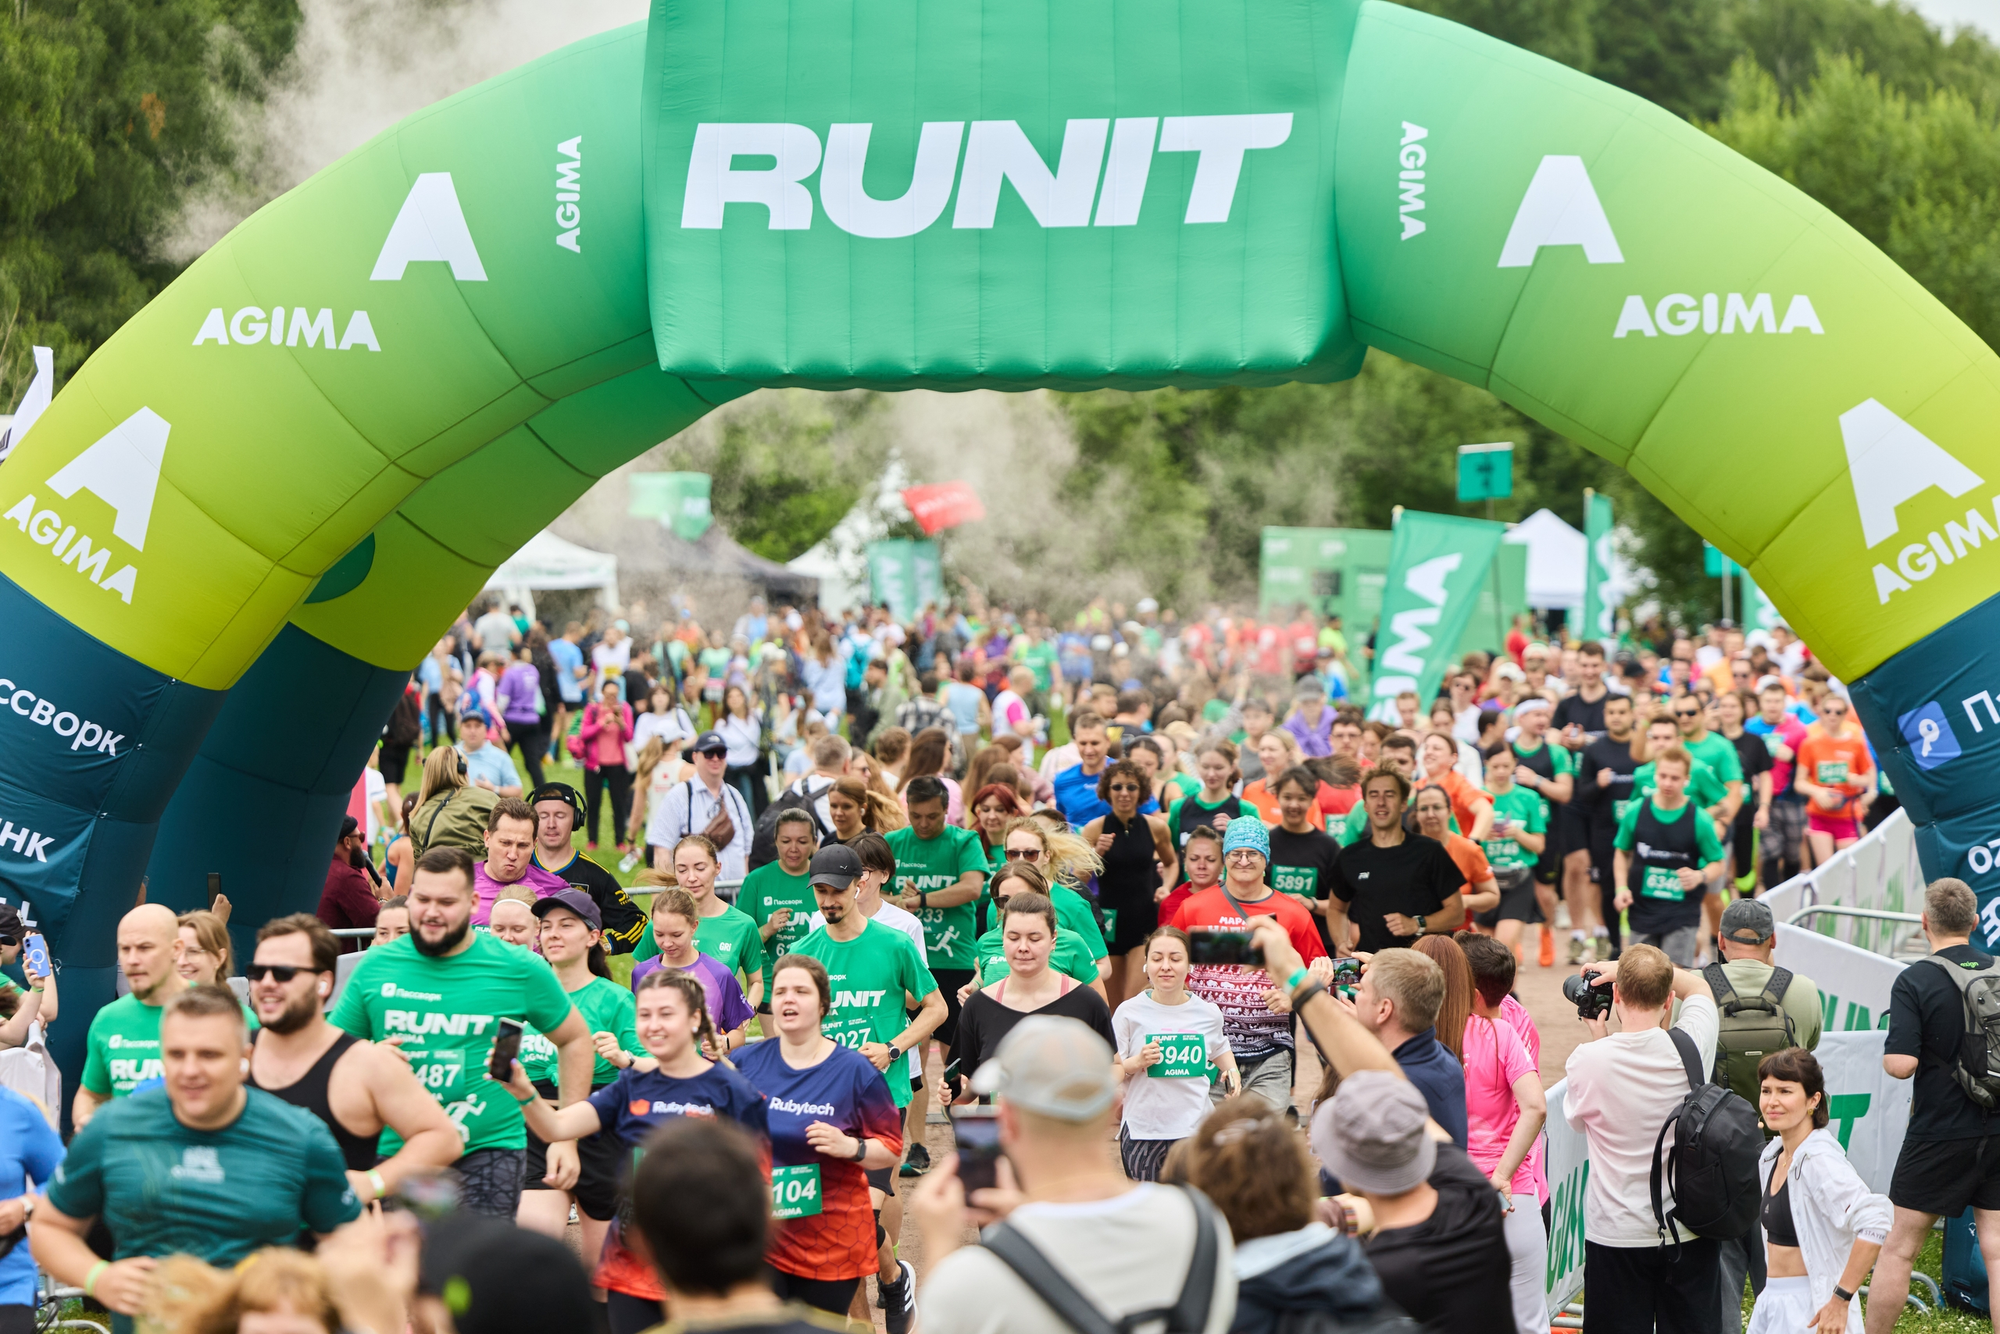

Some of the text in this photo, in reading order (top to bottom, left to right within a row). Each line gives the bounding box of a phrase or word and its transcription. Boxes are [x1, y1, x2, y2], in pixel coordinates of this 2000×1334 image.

[680, 112, 1294, 239] RUNIT
[1398, 120, 1430, 241] AGIMA
[555, 135, 583, 254] AGIMA
[192, 305, 382, 352] AGIMA
[1612, 292, 1826, 339] AGIMA
[2, 493, 138, 606] AGIMA
[1871, 493, 2000, 605] AGIM
[1961, 689, 2000, 733] П
[1274, 875, 1314, 891] 5891
[384, 1009, 495, 1035] RUNIT
[1153, 1045, 1203, 1065] 5940
[1164, 1068, 1190, 1076] AGIMA
[409, 1063, 461, 1088] 487
[652, 1101, 715, 1115] Rubytech
[769, 1096, 834, 1116] Rubytech
[772, 1177, 817, 1204] 104
[771, 1206, 803, 1218] AGIMA
[1546, 1158, 1591, 1295] GIM
